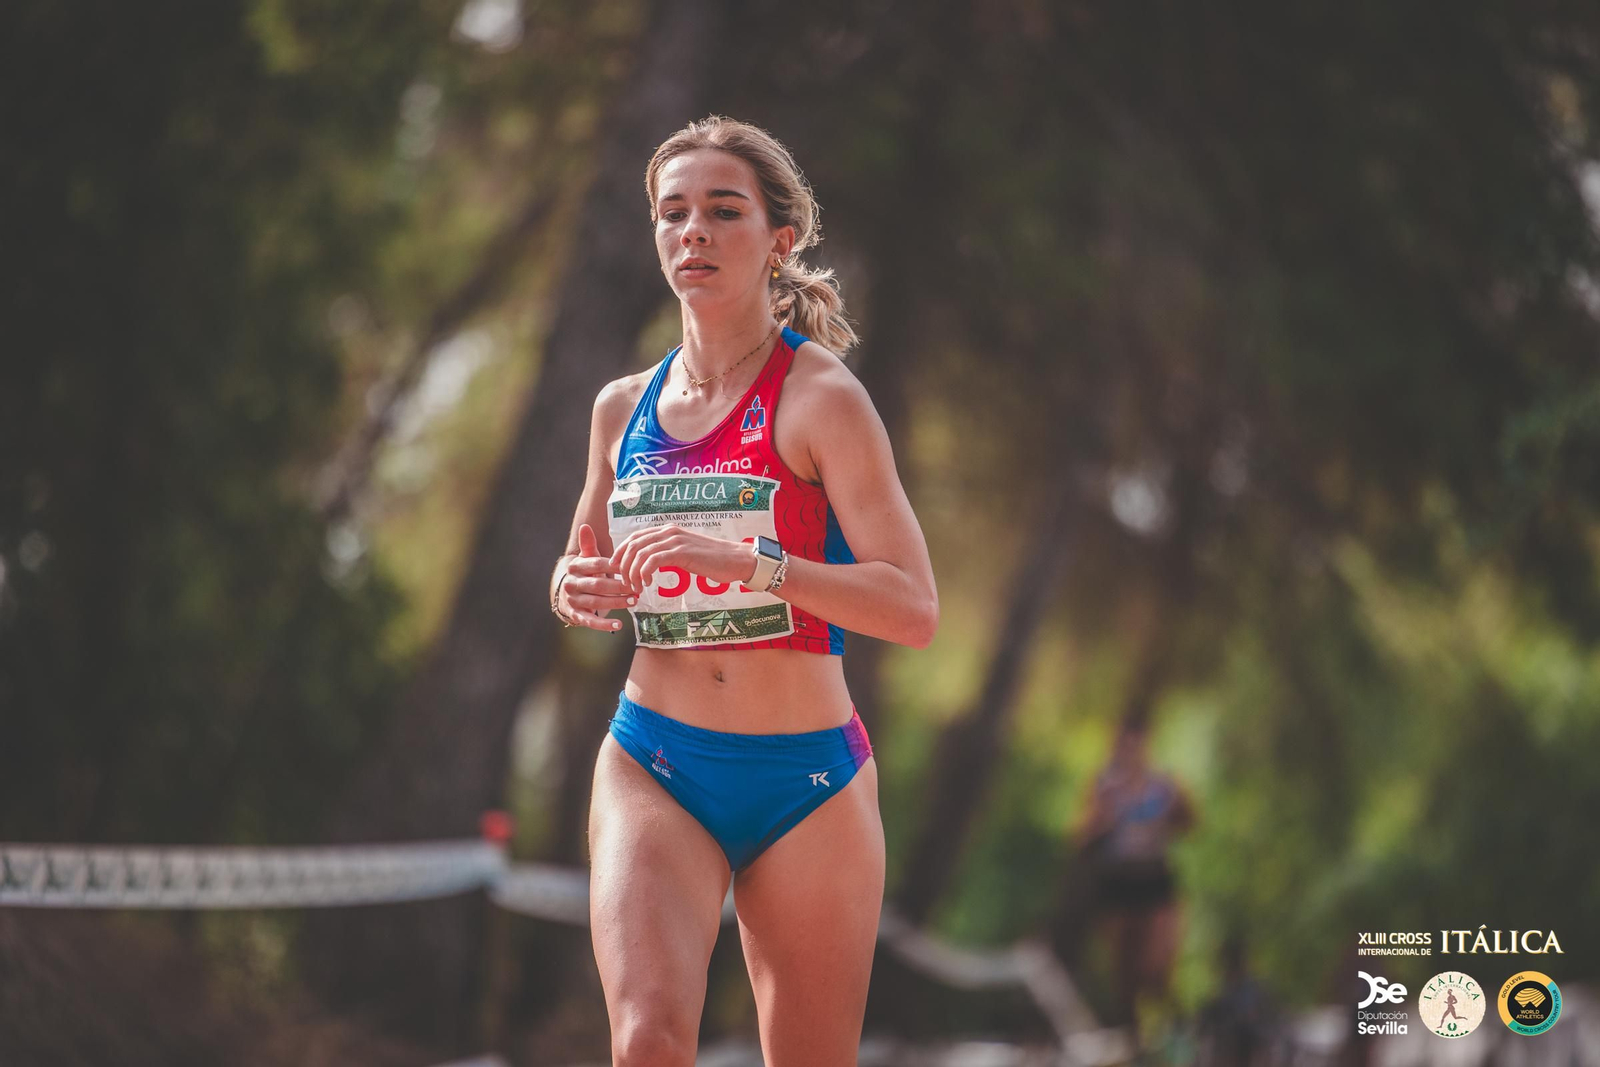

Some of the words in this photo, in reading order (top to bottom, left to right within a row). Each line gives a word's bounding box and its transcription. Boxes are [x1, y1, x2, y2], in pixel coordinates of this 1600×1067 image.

[651, 480, 727, 501] ITÁLICA
[635, 514, 664, 523] CLAUDIA
[665, 513, 699, 522] MARQUEZ
[700, 512, 743, 520] CONTRERAS
